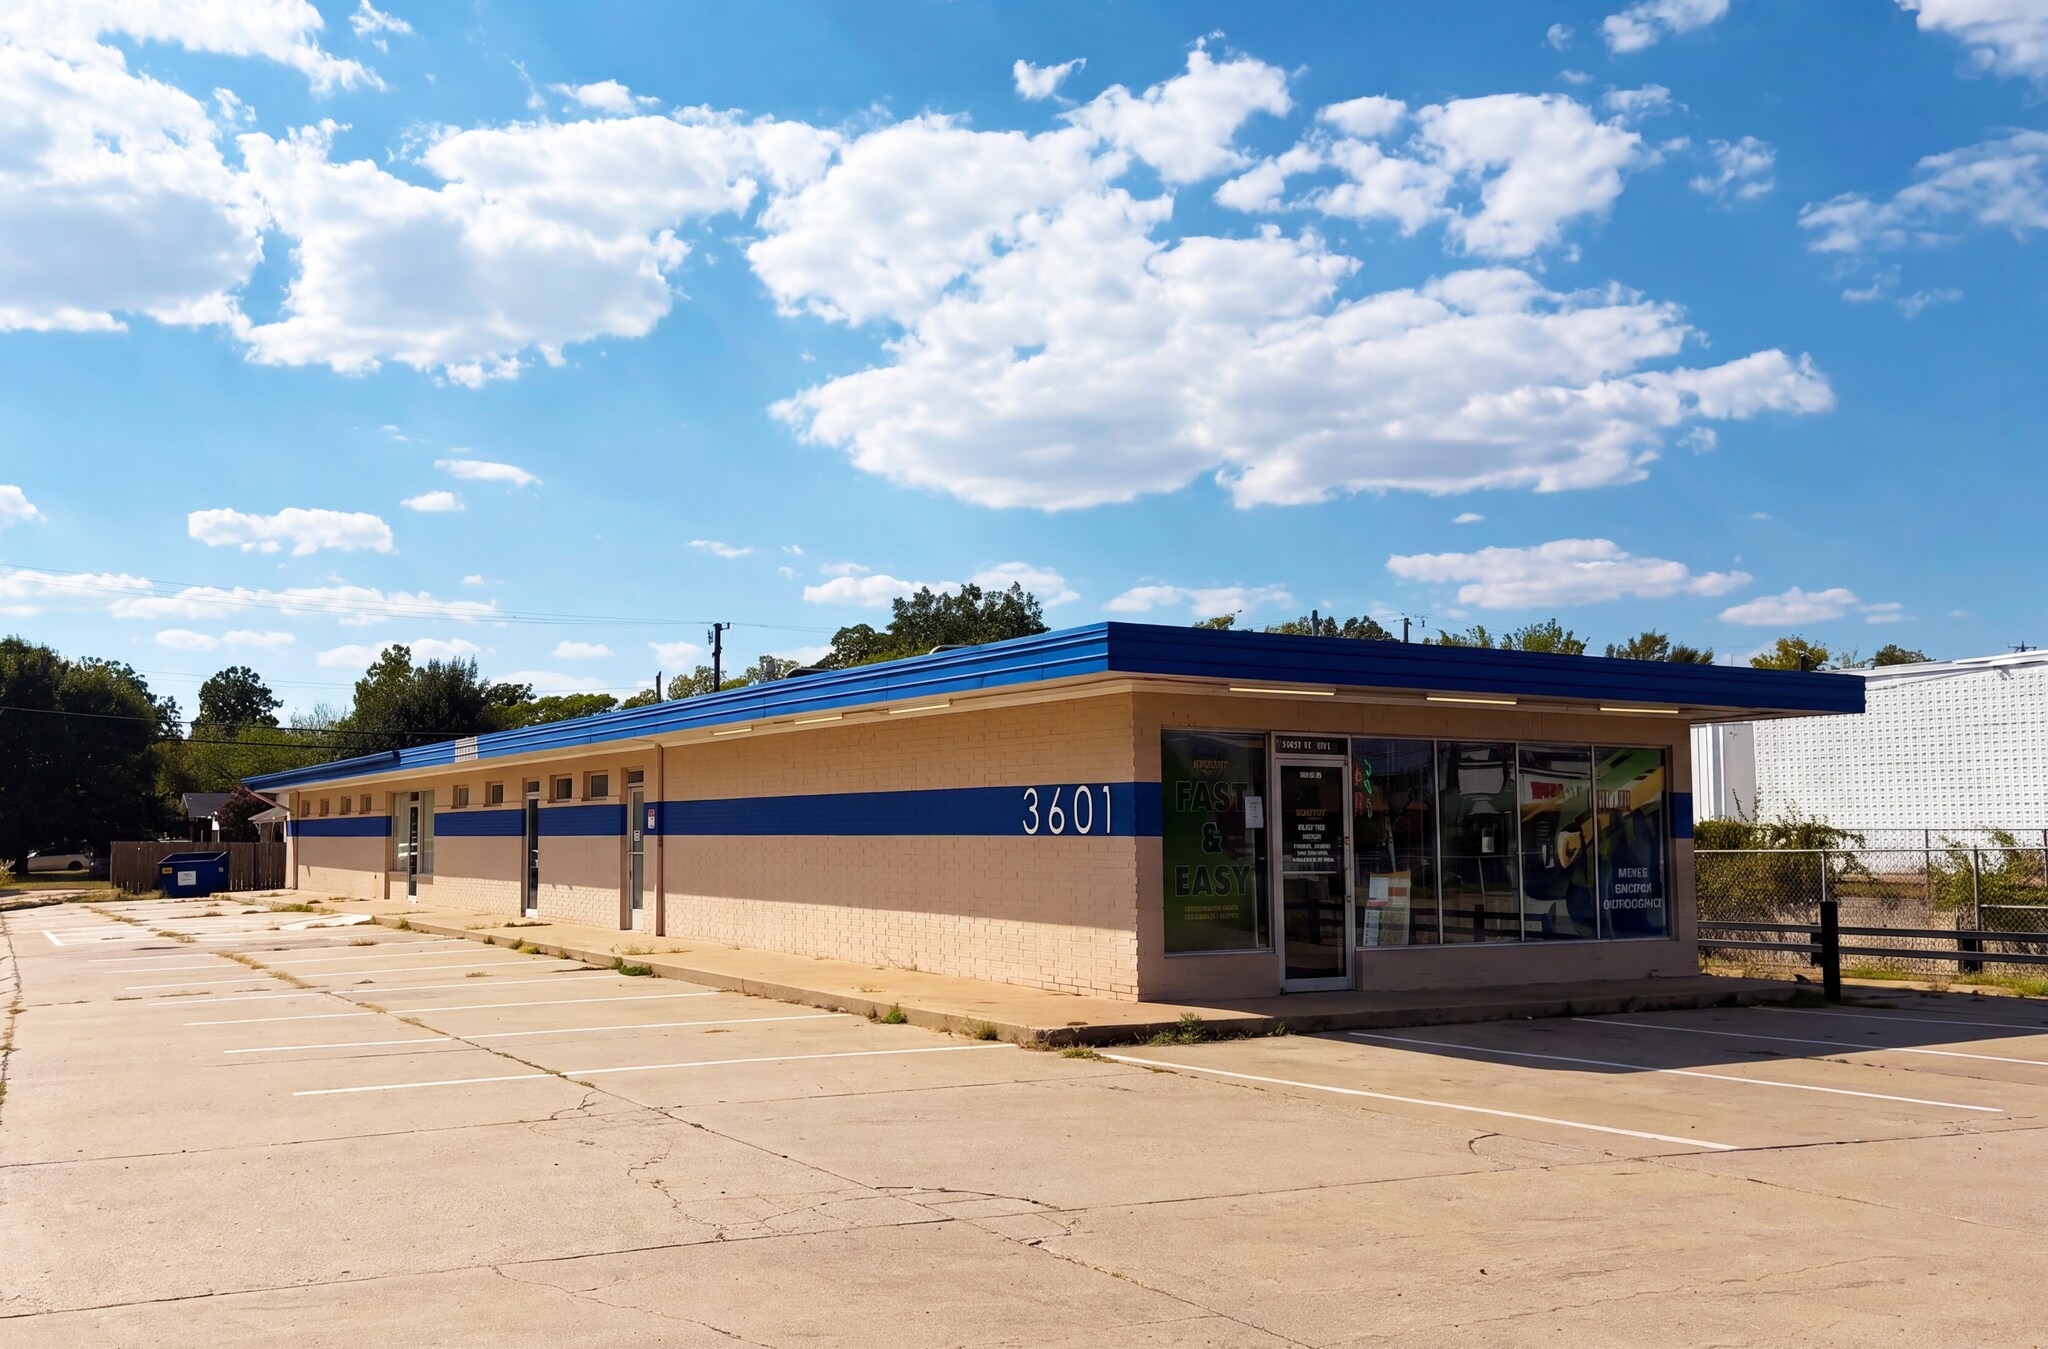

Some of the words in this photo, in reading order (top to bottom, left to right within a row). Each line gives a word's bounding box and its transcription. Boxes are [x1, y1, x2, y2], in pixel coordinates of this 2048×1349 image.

[1022, 785, 1111, 835] 3601
[1175, 781, 1249, 813] FAST
[1201, 821, 1223, 855] &
[1174, 864, 1252, 897] EASY
